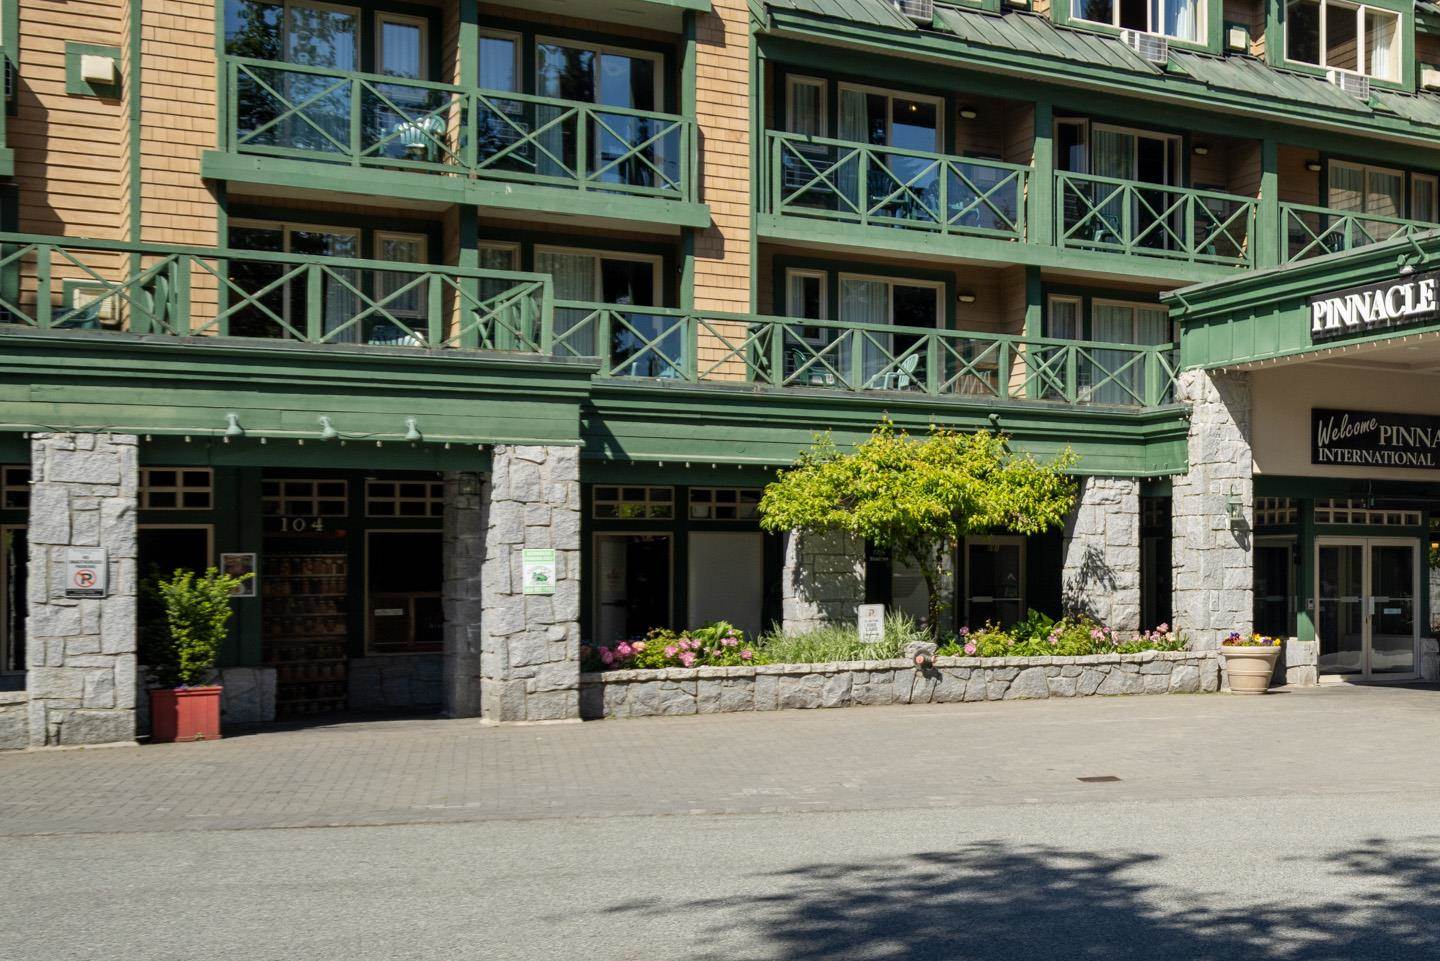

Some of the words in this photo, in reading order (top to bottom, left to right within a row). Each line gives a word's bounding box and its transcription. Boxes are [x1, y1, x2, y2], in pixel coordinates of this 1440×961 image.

[1312, 279, 1436, 332] PINNACLE
[1317, 413, 1378, 447] Welcome
[1318, 447, 1435, 466] INTERNATIONAL
[281, 517, 324, 532] 104
